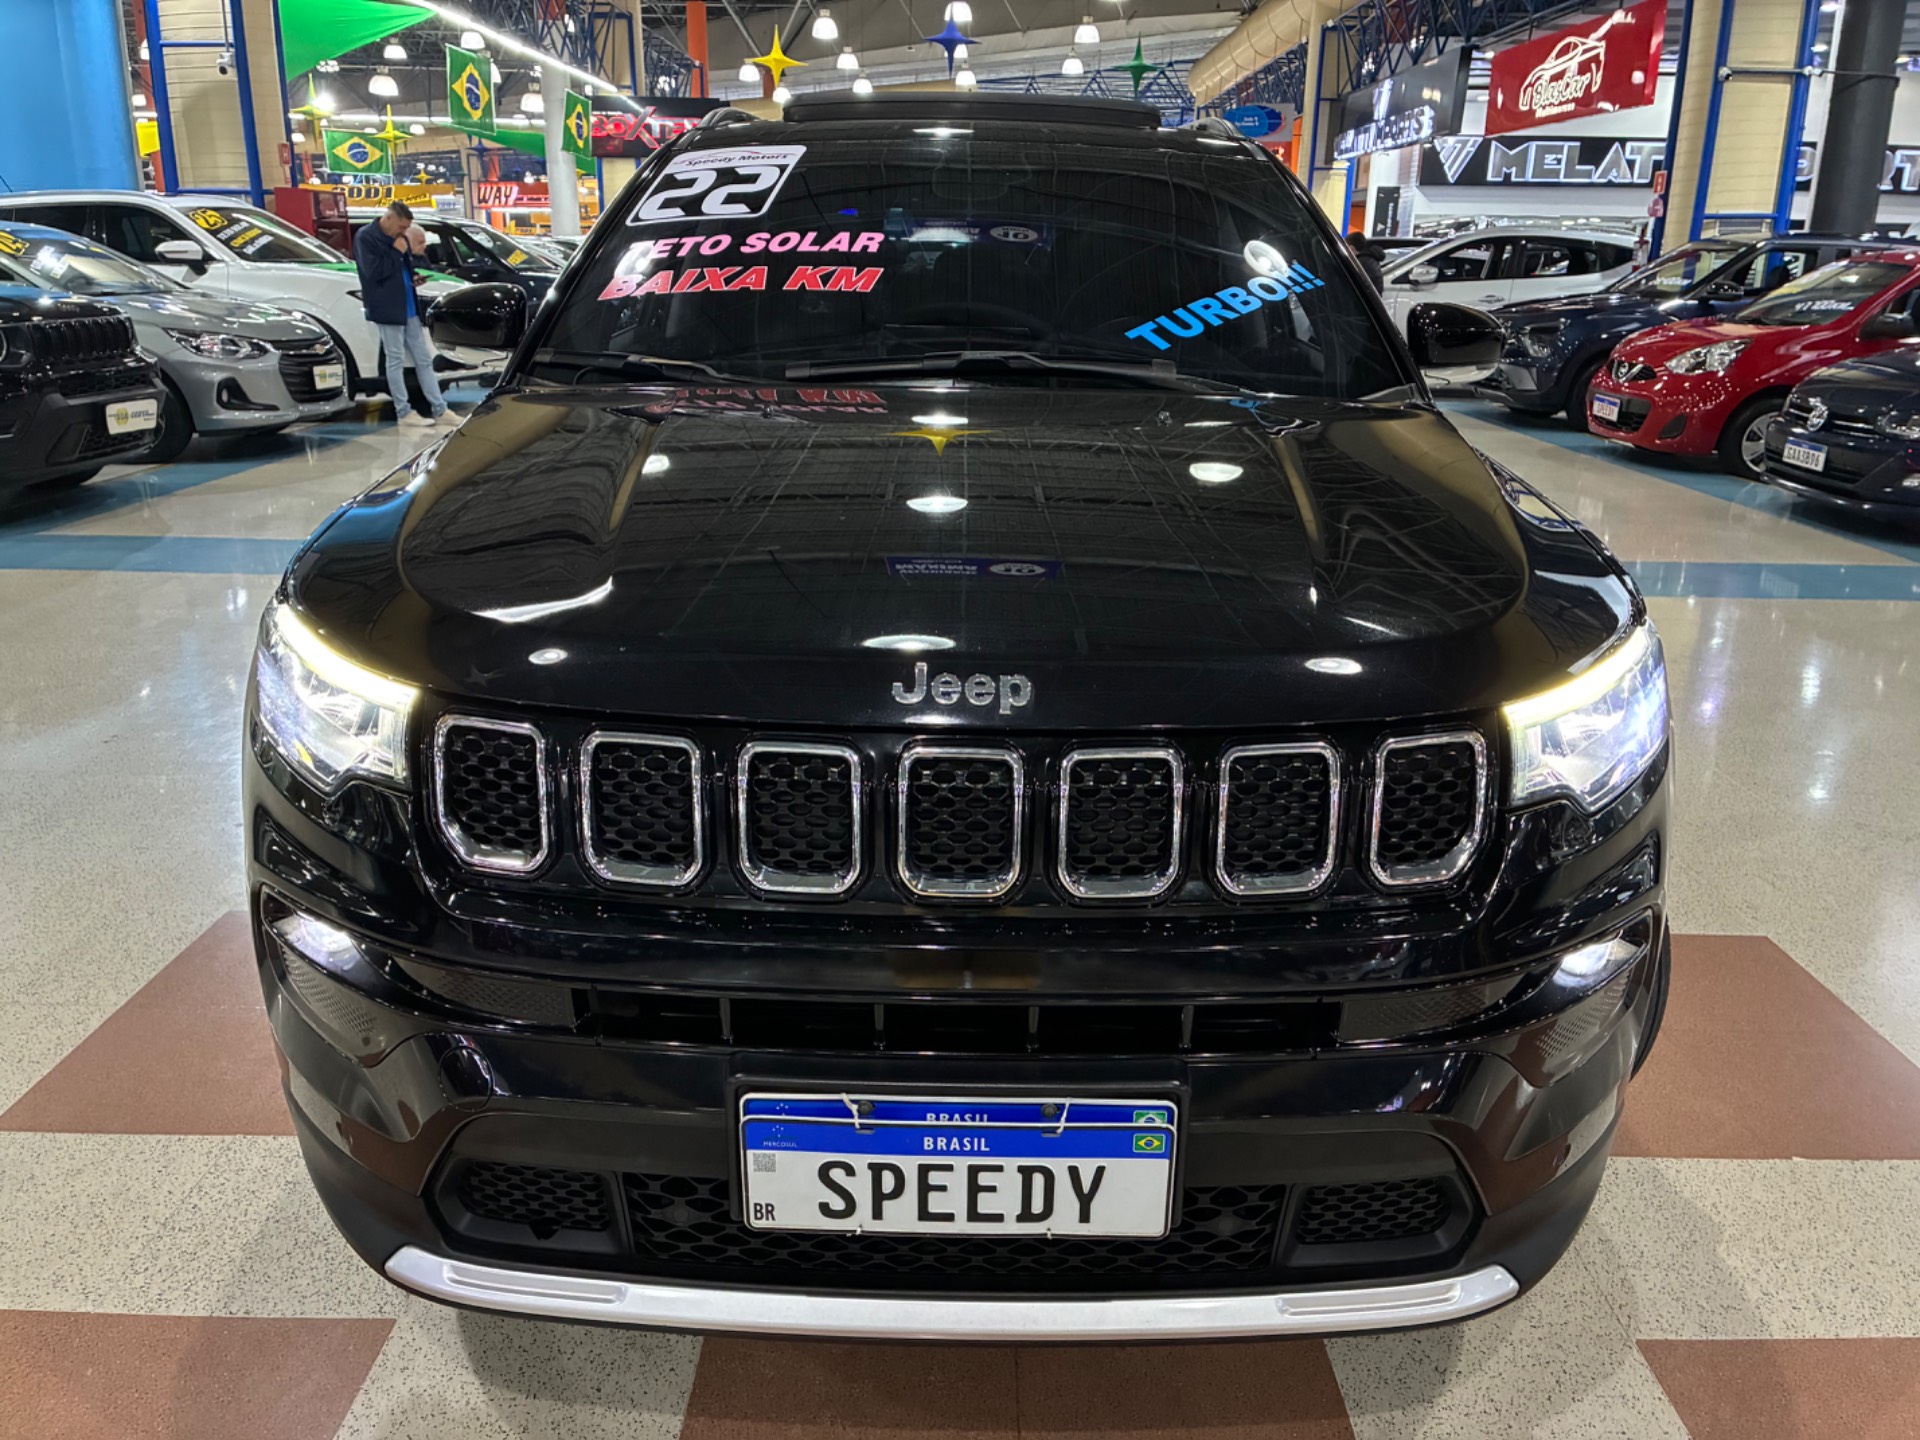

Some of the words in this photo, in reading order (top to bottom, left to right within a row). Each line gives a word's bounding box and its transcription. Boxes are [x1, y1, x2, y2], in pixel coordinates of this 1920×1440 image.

[686, 157, 736, 167] Speedy
[738, 153, 788, 162] Motors
[478, 184, 518, 207] WAY
[638, 166, 781, 220] 22
[740, 231, 885, 254] SOLAR
[597, 266, 768, 301] BAIXA
[783, 266, 884, 292] KM
[892, 662, 1033, 715] Jeep
[923, 1136, 990, 1152] BRASIL
[817, 1160, 1106, 1224] SPEEDY
[753, 1202, 776, 1222] BR
